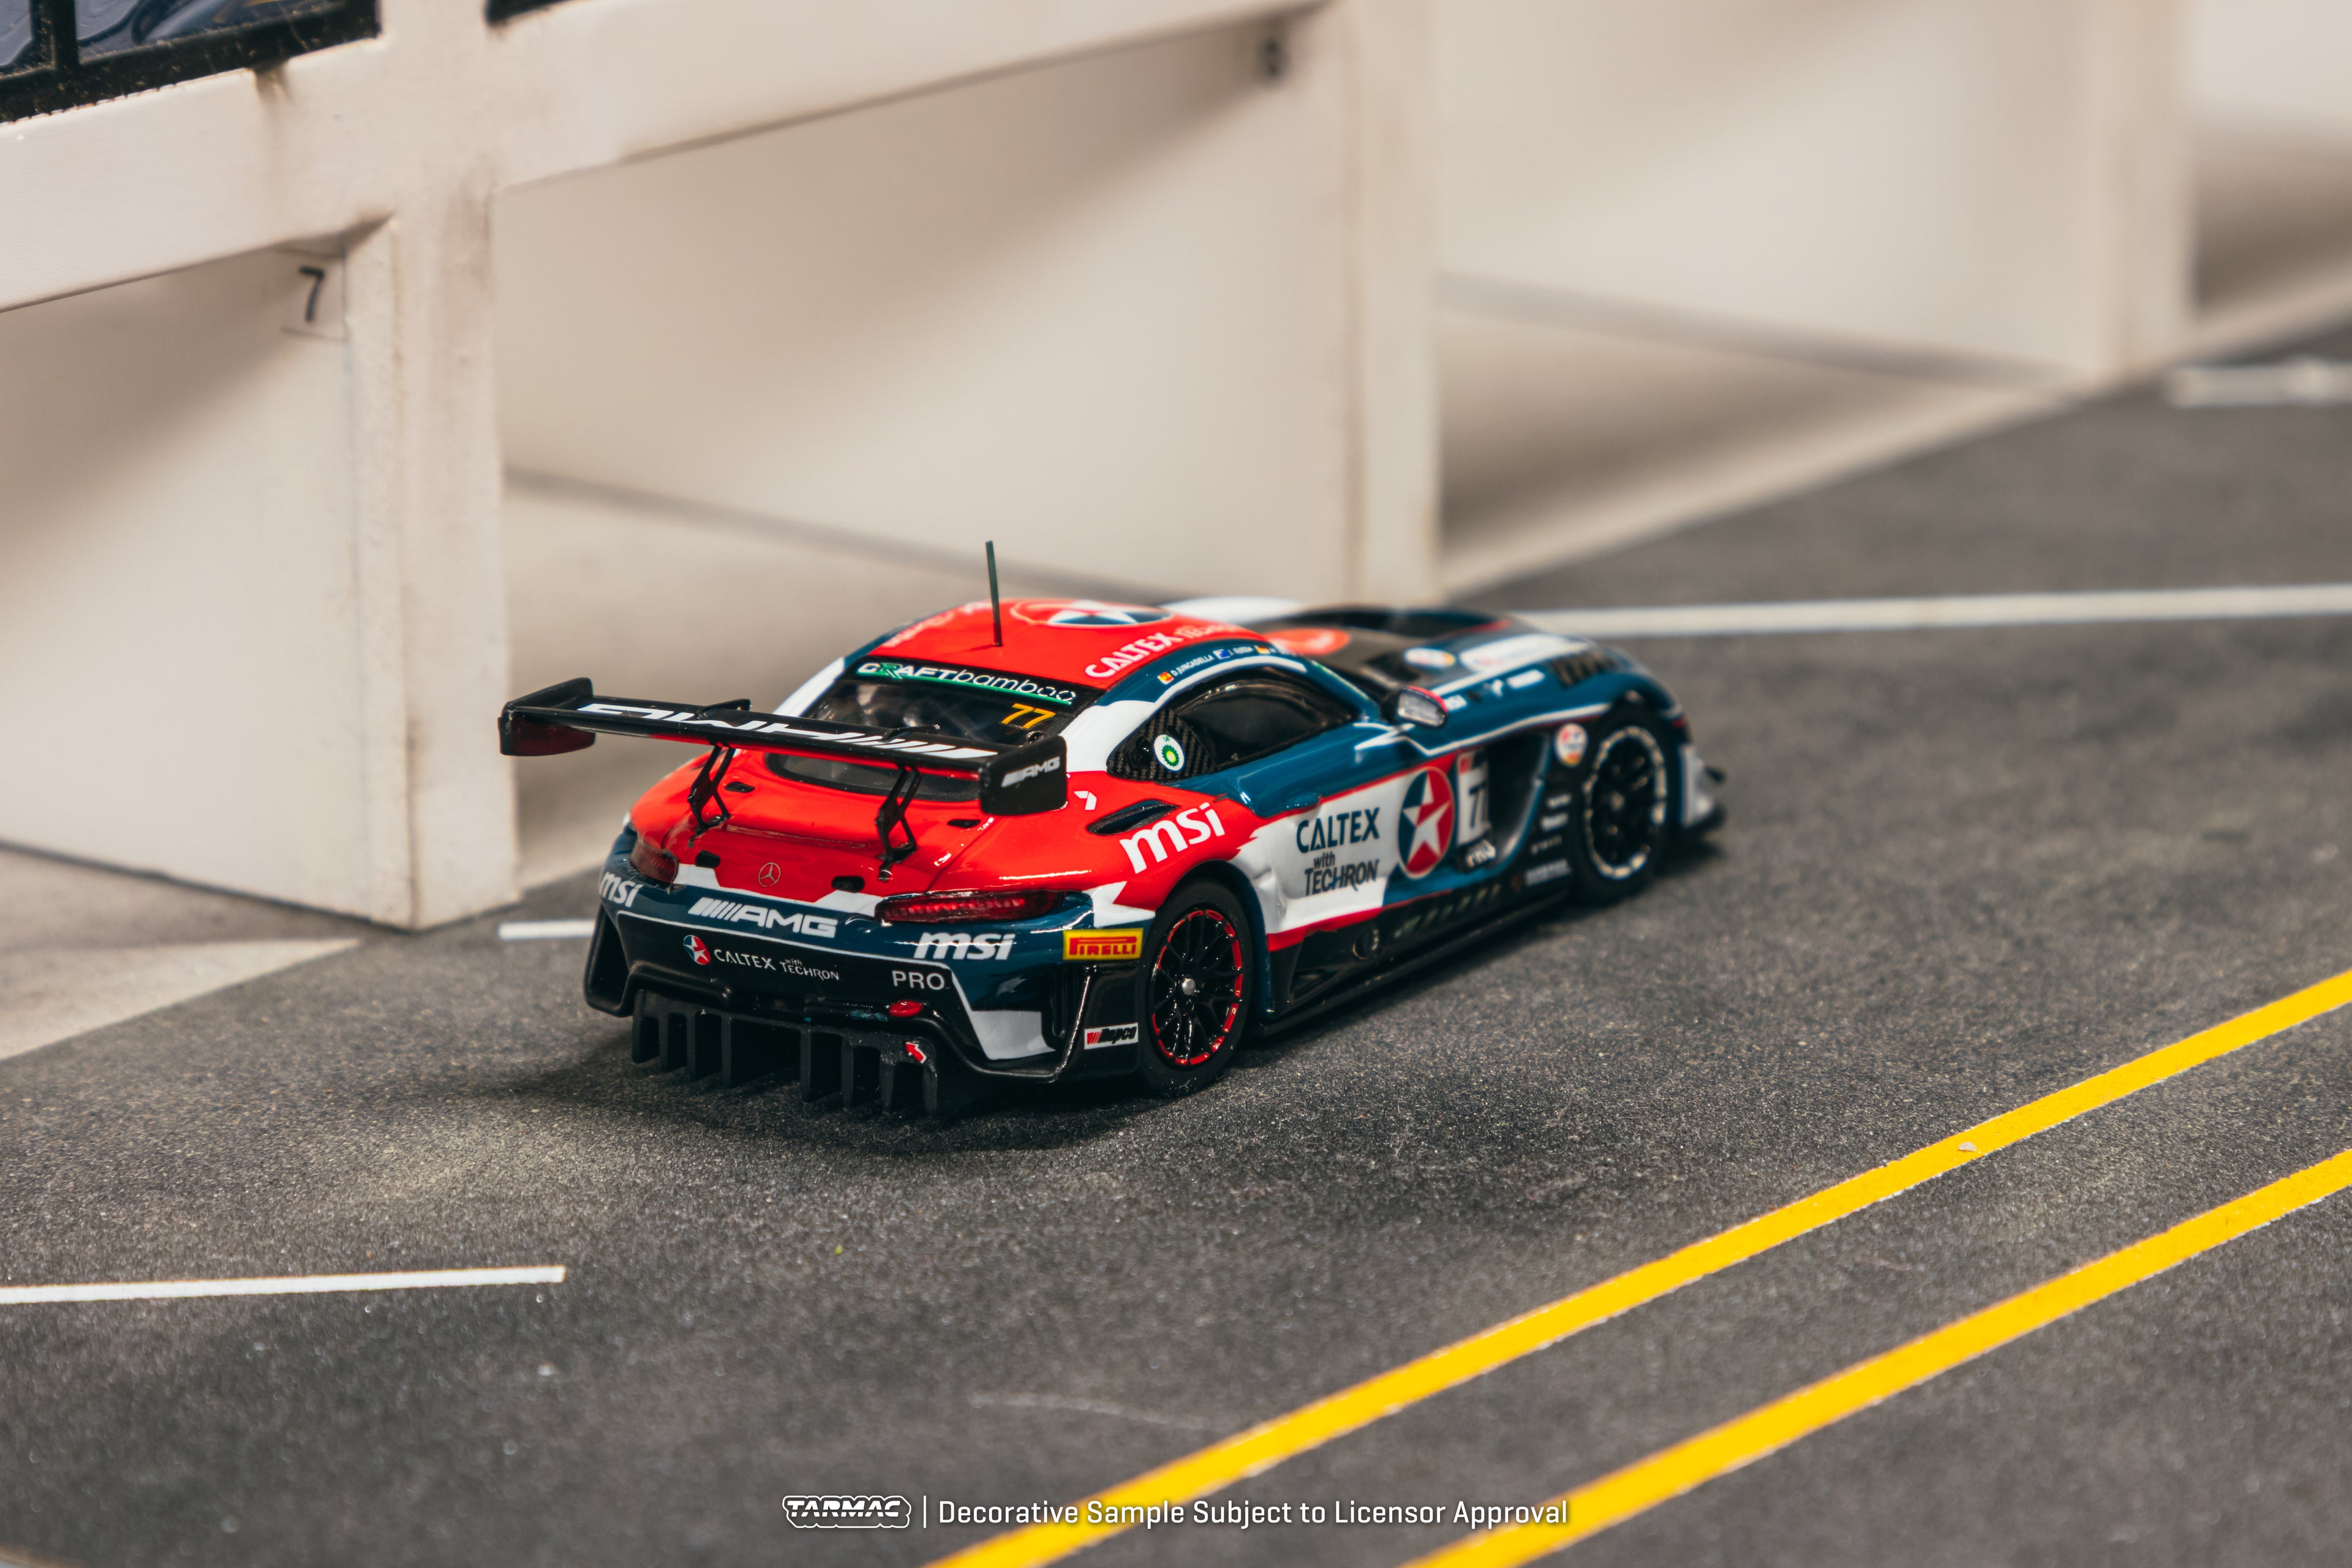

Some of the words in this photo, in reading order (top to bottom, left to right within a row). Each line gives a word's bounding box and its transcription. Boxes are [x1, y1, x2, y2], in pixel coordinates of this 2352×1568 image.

[298, 265, 326, 322] 7
[1085, 631, 1184, 678] CALTEX
[1001, 703, 1056, 729] 77
[1119, 802, 1225, 875] msi
[1296, 807, 1381, 853] CALTEX
[1313, 850, 1336, 870] with
[600, 871, 644, 908] msi
[1305, 859, 1380, 897] TECHRON
[913, 932, 1016, 960] msi
[1068, 937, 1137, 956] PIRELLI
[714, 949, 776, 971] CALTEX
[779, 962, 840, 981] TECHRON
[784, 957, 803, 967] with
[892, 970, 945, 990] PRO
